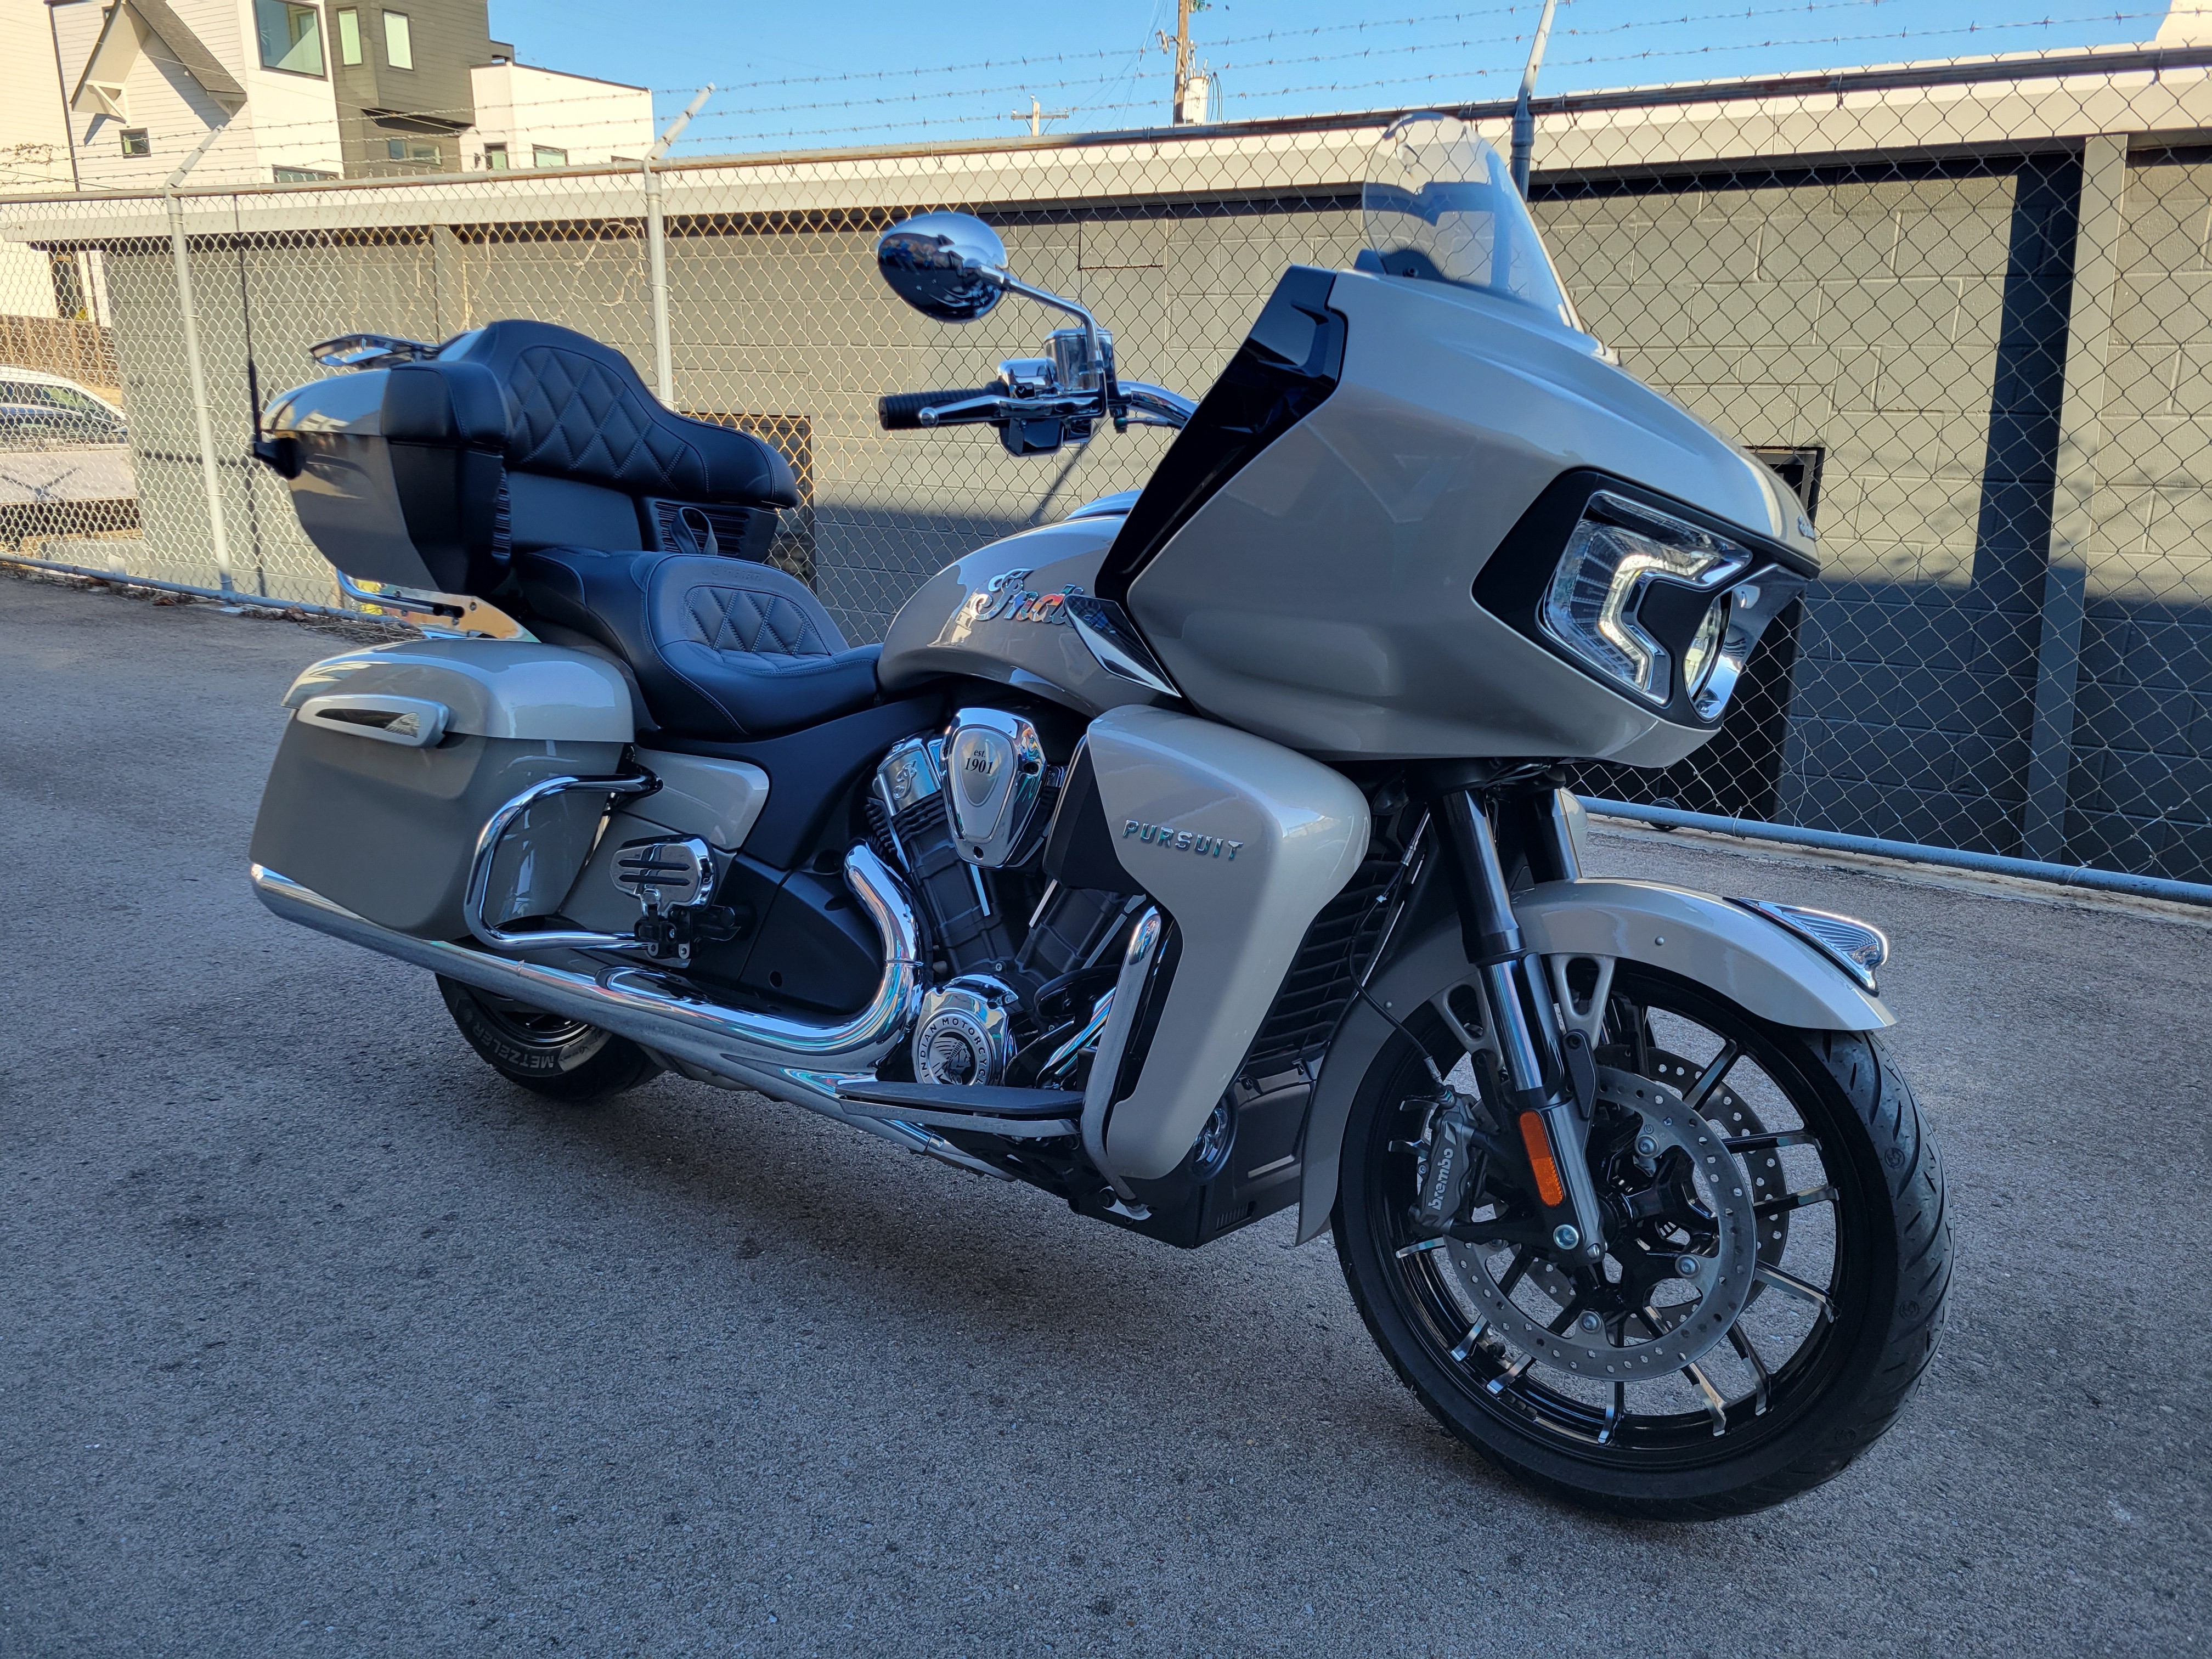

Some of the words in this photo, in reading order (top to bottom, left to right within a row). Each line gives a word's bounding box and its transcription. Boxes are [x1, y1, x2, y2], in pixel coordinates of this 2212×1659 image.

[970, 568, 1084, 627] Ind
[964, 757, 994, 774] 1901
[974, 749, 986, 758] est.
[1122, 820, 1244, 860] PURSUIT
[472, 1022, 554, 1069] METZELER
[920, 1026, 938, 1078] INDIAN
[942, 1017, 988, 1085] MOTORCYCL
[1428, 1148, 1454, 1210] brembo
